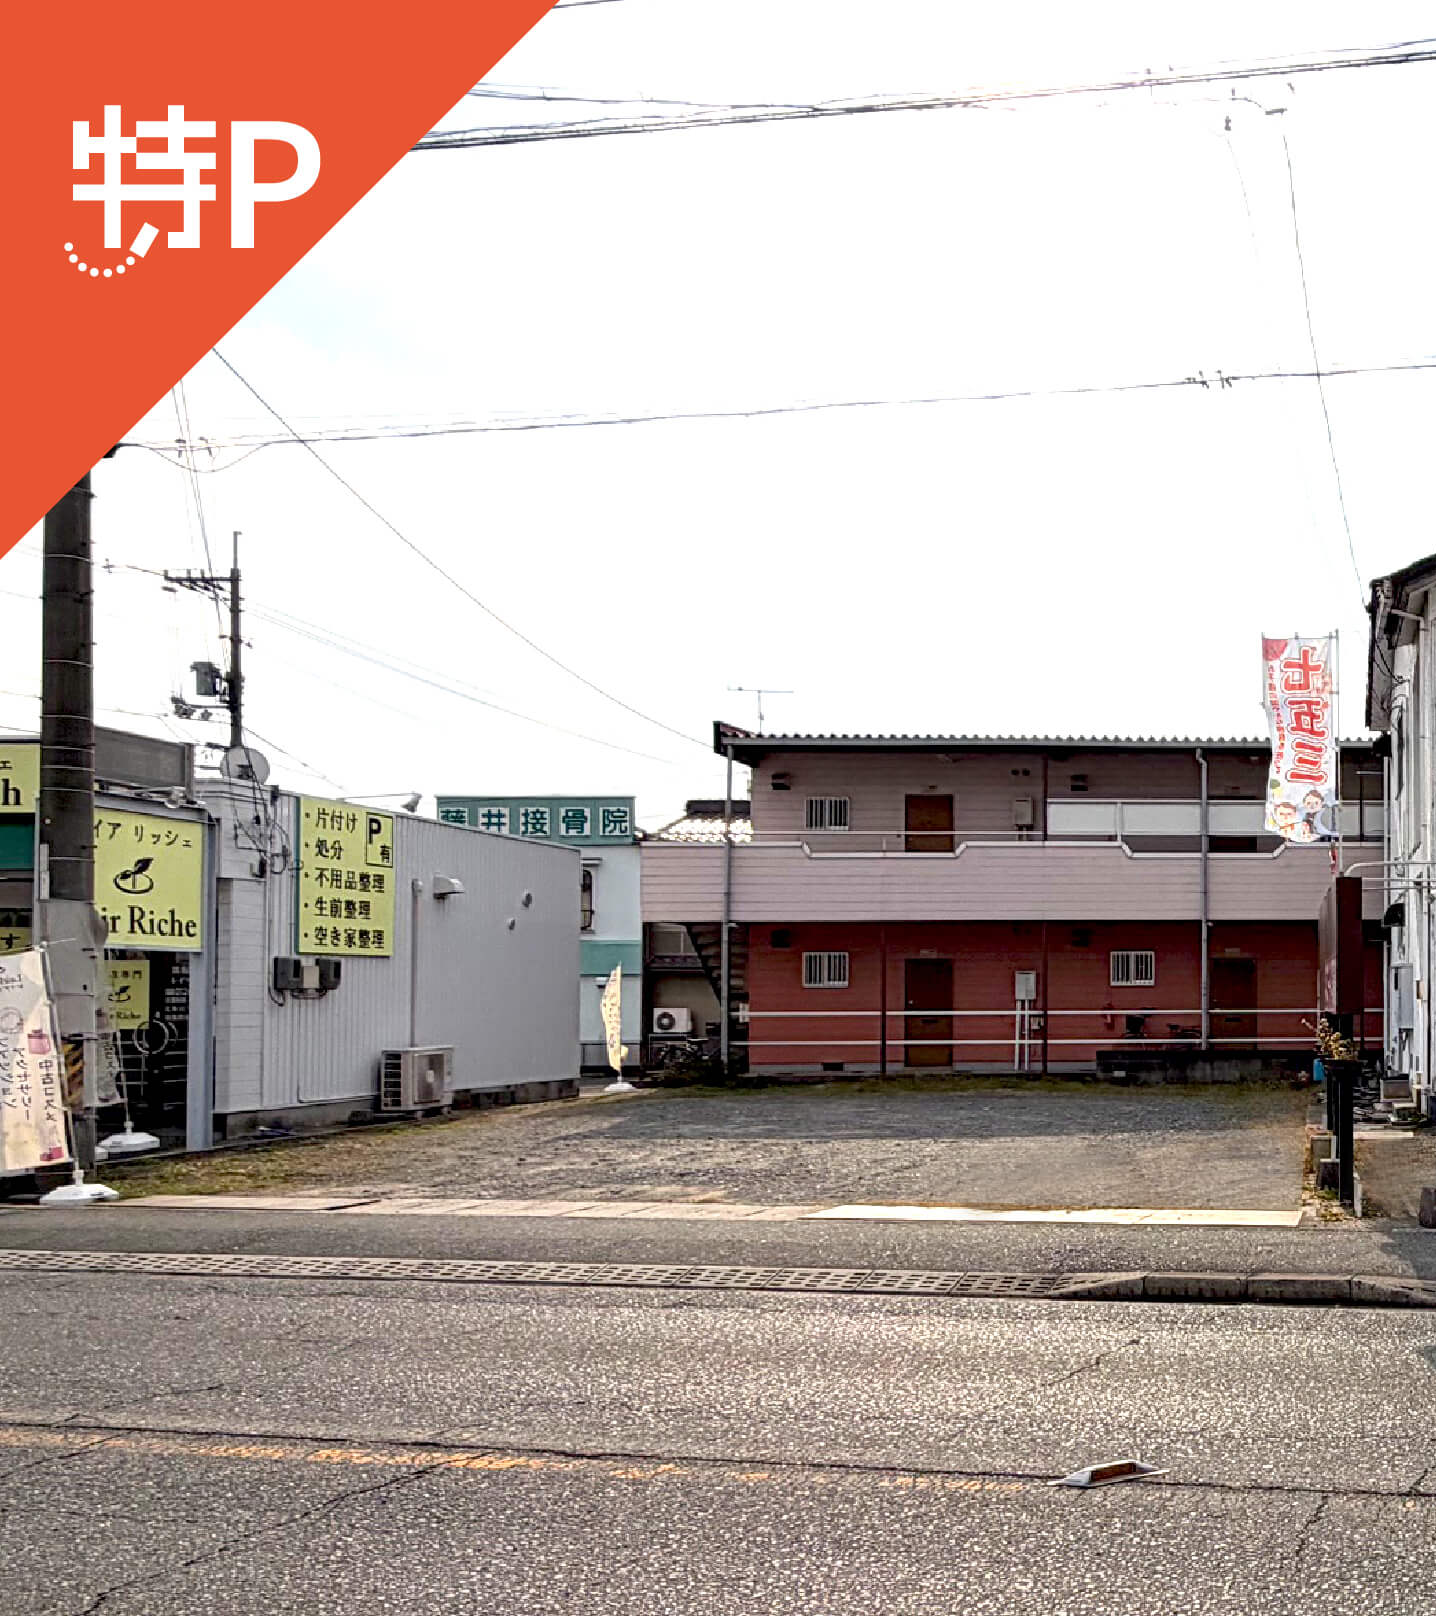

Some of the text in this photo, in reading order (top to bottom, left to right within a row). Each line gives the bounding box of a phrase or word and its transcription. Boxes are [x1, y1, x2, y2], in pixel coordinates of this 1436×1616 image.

[315, 807, 358, 833] 片付け
[368, 818, 382, 845] P
[134, 823, 192, 848] リッシェ
[315, 836, 344, 860] 処分
[380, 844, 390, 863] 有
[315, 867, 385, 893] 不用品整理
[314, 896, 371, 919] 生前整理
[128, 904, 197, 938] Riche
[314, 926, 385, 949] 空き家整理
